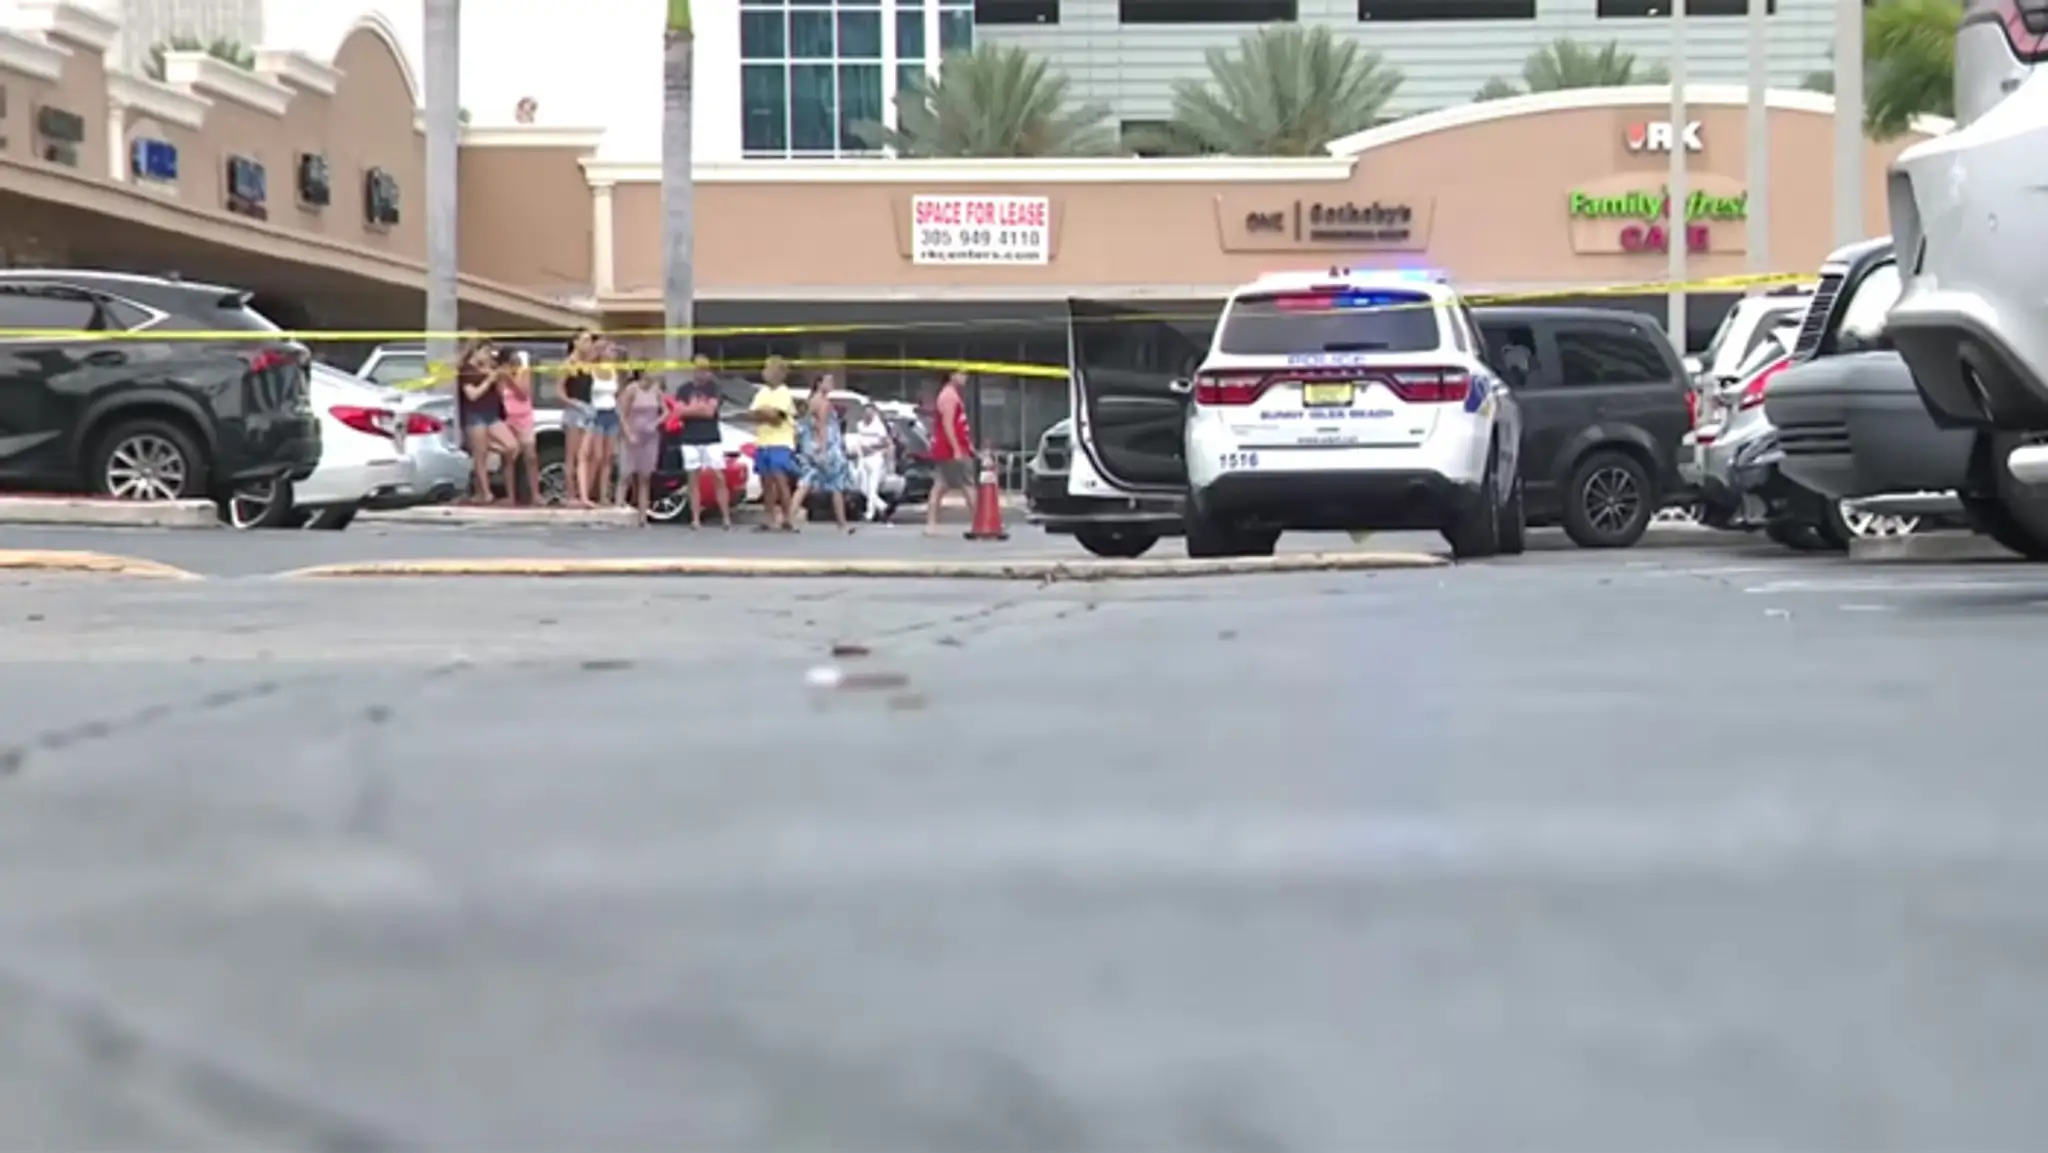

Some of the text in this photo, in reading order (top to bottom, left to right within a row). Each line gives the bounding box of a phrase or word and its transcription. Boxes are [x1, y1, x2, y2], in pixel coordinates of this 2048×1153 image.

[915, 200, 1046, 227] SPACE FOR LEASE
[1569, 188, 1661, 221] Family
[920, 228, 1040, 247] 305 949 4110
[1259, 409, 1304, 421] SUNNY
[1349, 408, 1394, 419] BEACH
[1218, 452, 1259, 469] 1516
